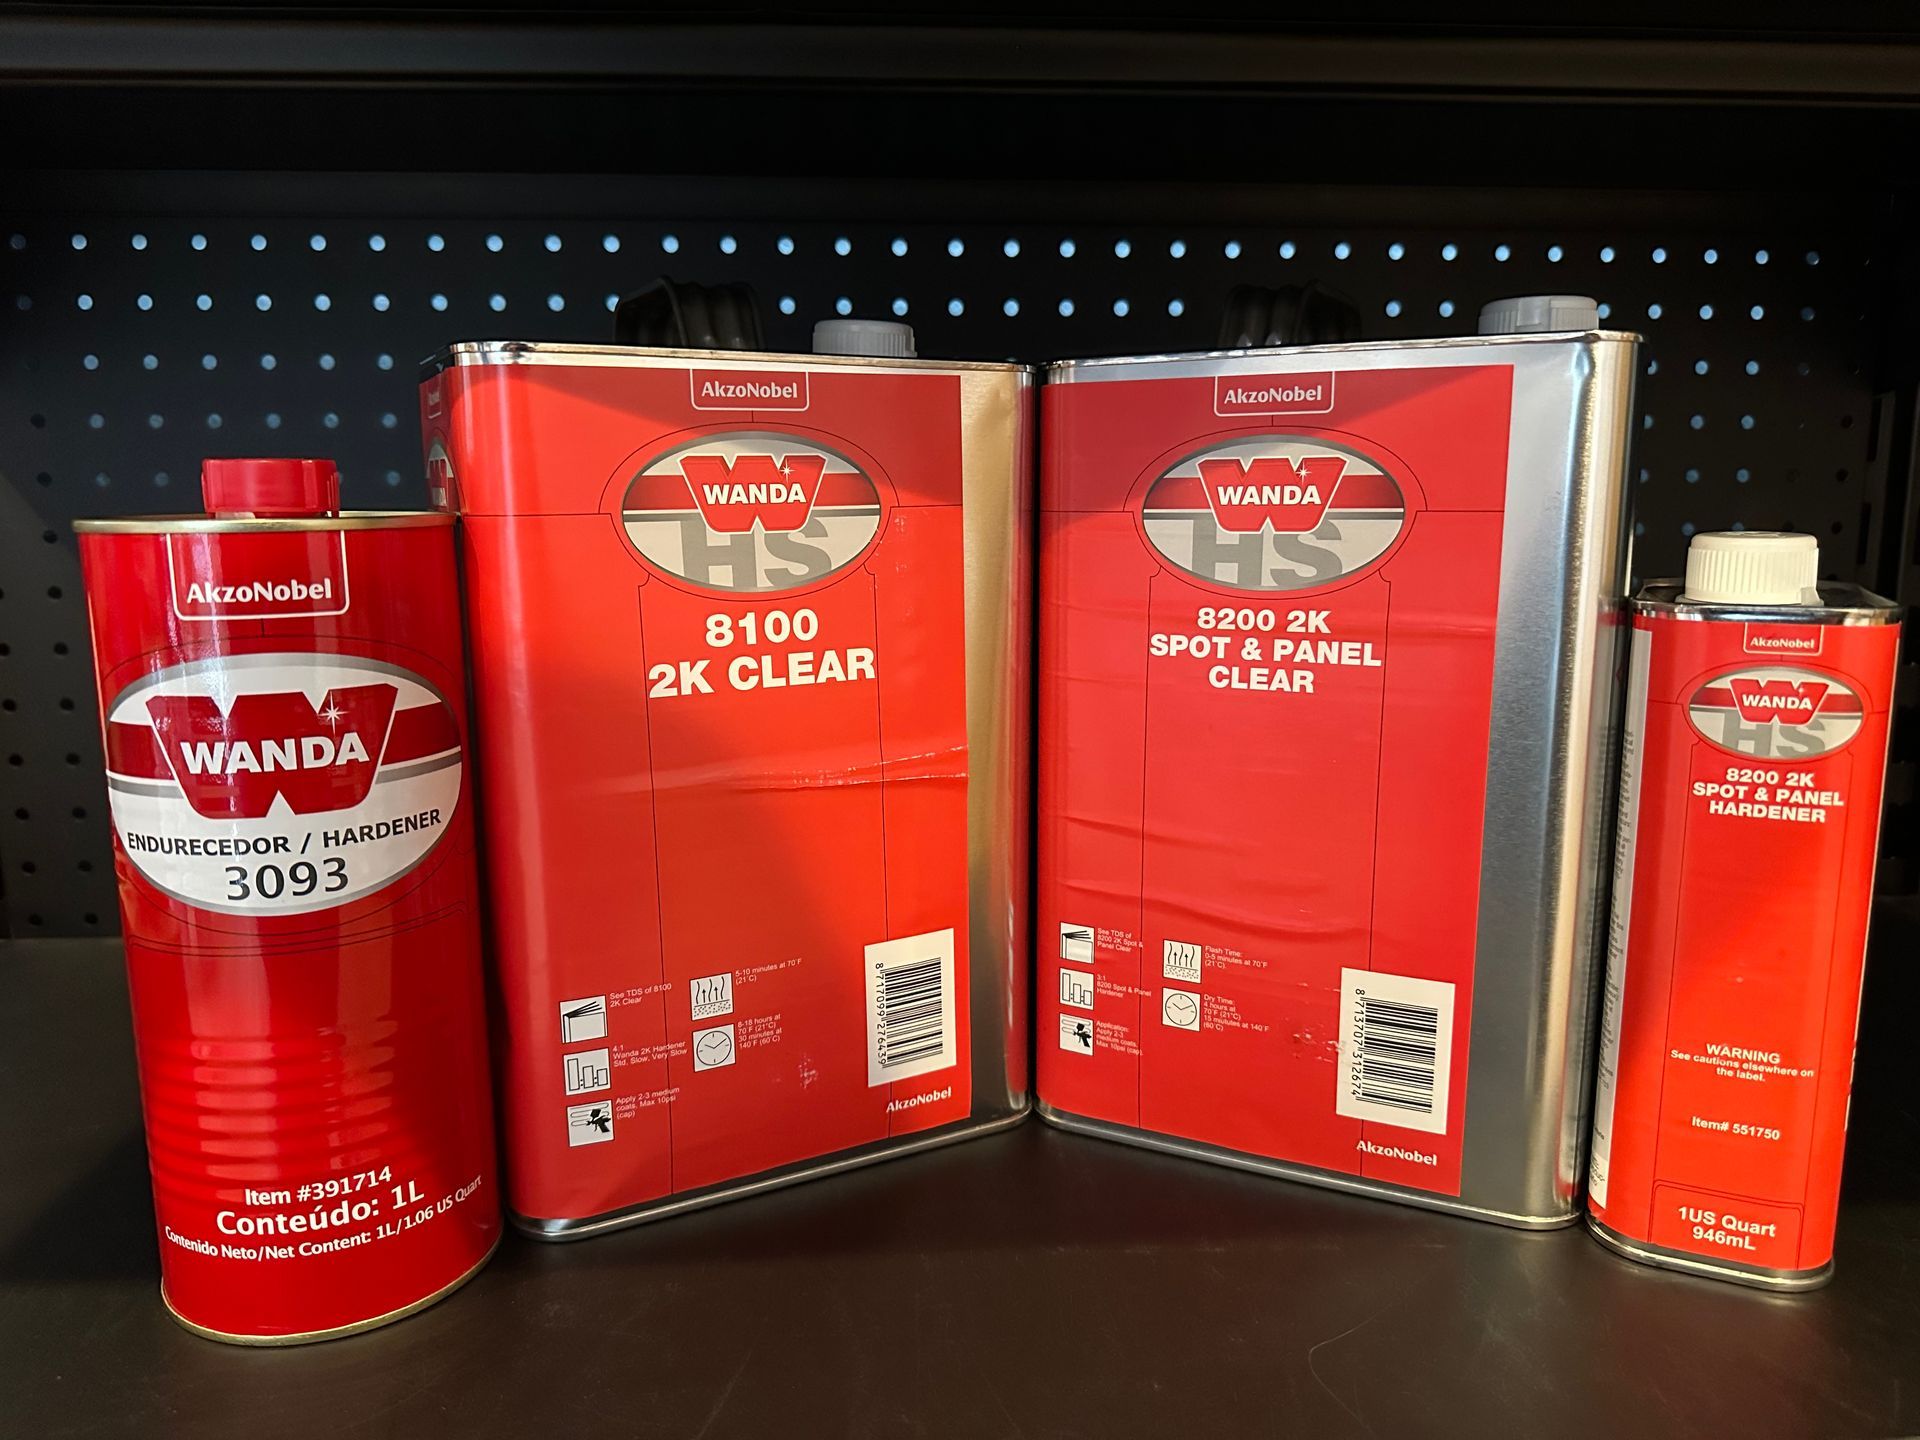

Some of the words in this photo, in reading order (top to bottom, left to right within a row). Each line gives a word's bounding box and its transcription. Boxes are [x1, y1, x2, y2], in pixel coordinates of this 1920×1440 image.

[701, 381, 798, 399] AkzoNobel
[1224, 385, 1322, 405] AkzoNobel
[703, 483, 807, 506] WANDA
[1217, 485, 1321, 506] WANDA
[186, 578, 332, 605] AkzoNobel
[705, 608, 819, 648] 8100
[1197, 607, 1275, 632] 8200
[1287, 609, 1332, 634] 2K
[1150, 634, 1231, 658] SPOT
[1241, 637, 1262, 660] &
[1273, 639, 1382, 667] PANEL
[1750, 637, 1814, 649] AkzoNobel
[648, 659, 715, 699] 2K
[728, 647, 875, 691] CLEAR
[1208, 665, 1314, 693] CLEAR
[1742, 694, 1813, 710] WANDA
[180, 731, 370, 776] WANDA
[1726, 768, 1779, 784] 8200
[1786, 772, 1814, 788] 2K
[1692, 782, 1748, 799] SPOT
[1754, 787, 1768, 801] &
[1776, 790, 1844, 807] PANEL
[1709, 801, 1826, 823] HARDENER
[128, 832, 290, 856] ENDURECEDOR
[301, 833, 311, 854] /
[323, 808, 441, 848] HARDENER
[224, 858, 349, 901] 3093
[1097, 940, 1114, 949] Panel
[1116, 944, 1132, 952] Clear
[1205, 945, 1223, 954] Flash
[1205, 952, 1216, 960] 0-5
[1217, 955, 1242, 965] minutes
[735, 968, 751, 977] 5-10
[752, 964, 778, 973] minutes
[779, 961, 786, 969] at
[610, 992, 624, 1000] See
[627, 988, 643, 997] TDS
[645, 986, 652, 994] of
[654, 983, 672, 992] 8100
[1096, 980, 1112, 989] 8200
[1113, 984, 1127, 992] Spot
[1134, 987, 1152, 997] Panel
[1096, 988, 1124, 998] Hardener
[1203, 994, 1215, 1002] Dry
[610, 1000, 621, 1008] 2K
[623, 997, 642, 1005] Clear
[1209, 1002, 1228, 1011] hours
[754, 1015, 773, 1025] hours
[748, 1030, 774, 1040] minutes
[1096, 1027, 1113, 1036] Apply
[613, 1050, 639, 1059] Wanda
[641, 1047, 651, 1055] 2K
[653, 1041, 686, 1053] Hardener
[652, 1051, 669, 1060] Very
[670, 1048, 688, 1057] Slow
[1706, 1043, 1781, 1065] WARNING
[1670, 1050, 1691, 1061] See
[1693, 1054, 1739, 1069] cautions
[1742, 1061, 1798, 1077] elsewhere
[1800, 1069, 1814, 1078] on
[1716, 1067, 1734, 1077] the
[1736, 1068, 1766, 1082] label.
[616, 1095, 636, 1104] Apply
[651, 1087, 680, 1097] medium
[640, 1099, 655, 1107] Max
[658, 1095, 677, 1104] 10psi
[886, 1086, 952, 1113] AkzoNobel
[616, 1110, 636, 1120] (cap)
[1692, 1116, 1729, 1132] Item#
[1732, 1123, 1780, 1141] 551750
[1356, 1140, 1438, 1167] AkzoNobel
[245, 1189, 291, 1206] Item
[297, 1165, 392, 1201] #391714
[216, 1198, 379, 1236] Conteúdo:
[392, 1180, 425, 1210] 1L
[165, 1225, 218, 1257] Contenido
[222, 1244, 295, 1262] Neto/Net
[299, 1231, 372, 1257] Content:
[376, 1206, 434, 1240] 1L/1.06
[437, 1194, 453, 1215] US
[455, 1175, 483, 1203] Quart
[1678, 1207, 1717, 1226] 1US
[1721, 1214, 1776, 1238] Quart
[1692, 1226, 1757, 1250] 946mL
